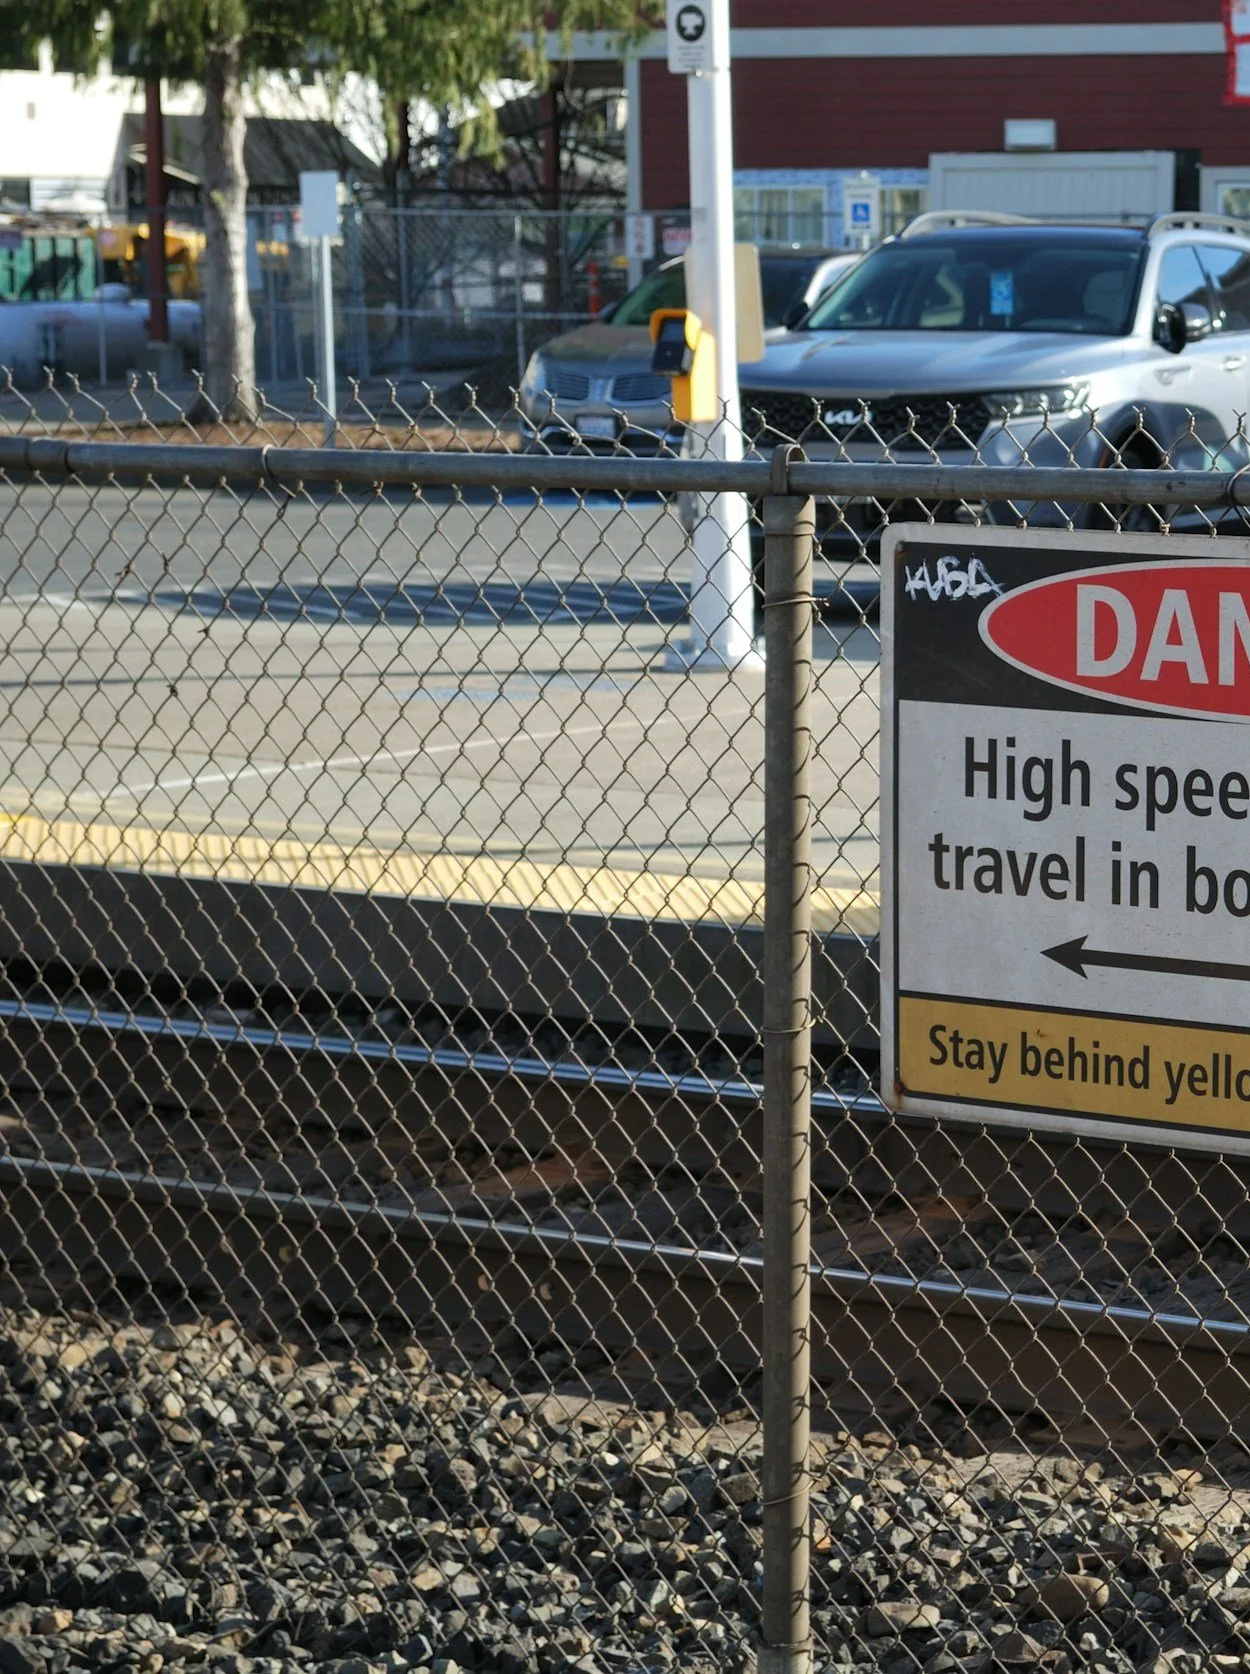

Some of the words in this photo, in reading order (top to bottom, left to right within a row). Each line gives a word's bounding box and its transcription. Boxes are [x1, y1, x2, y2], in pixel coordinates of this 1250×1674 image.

[965, 737, 1090, 821] High
[929, 833, 1085, 901] travel
[1112, 841, 1159, 908] in
[930, 1025, 1008, 1084] Stay
[1021, 1033, 1149, 1089] behind
